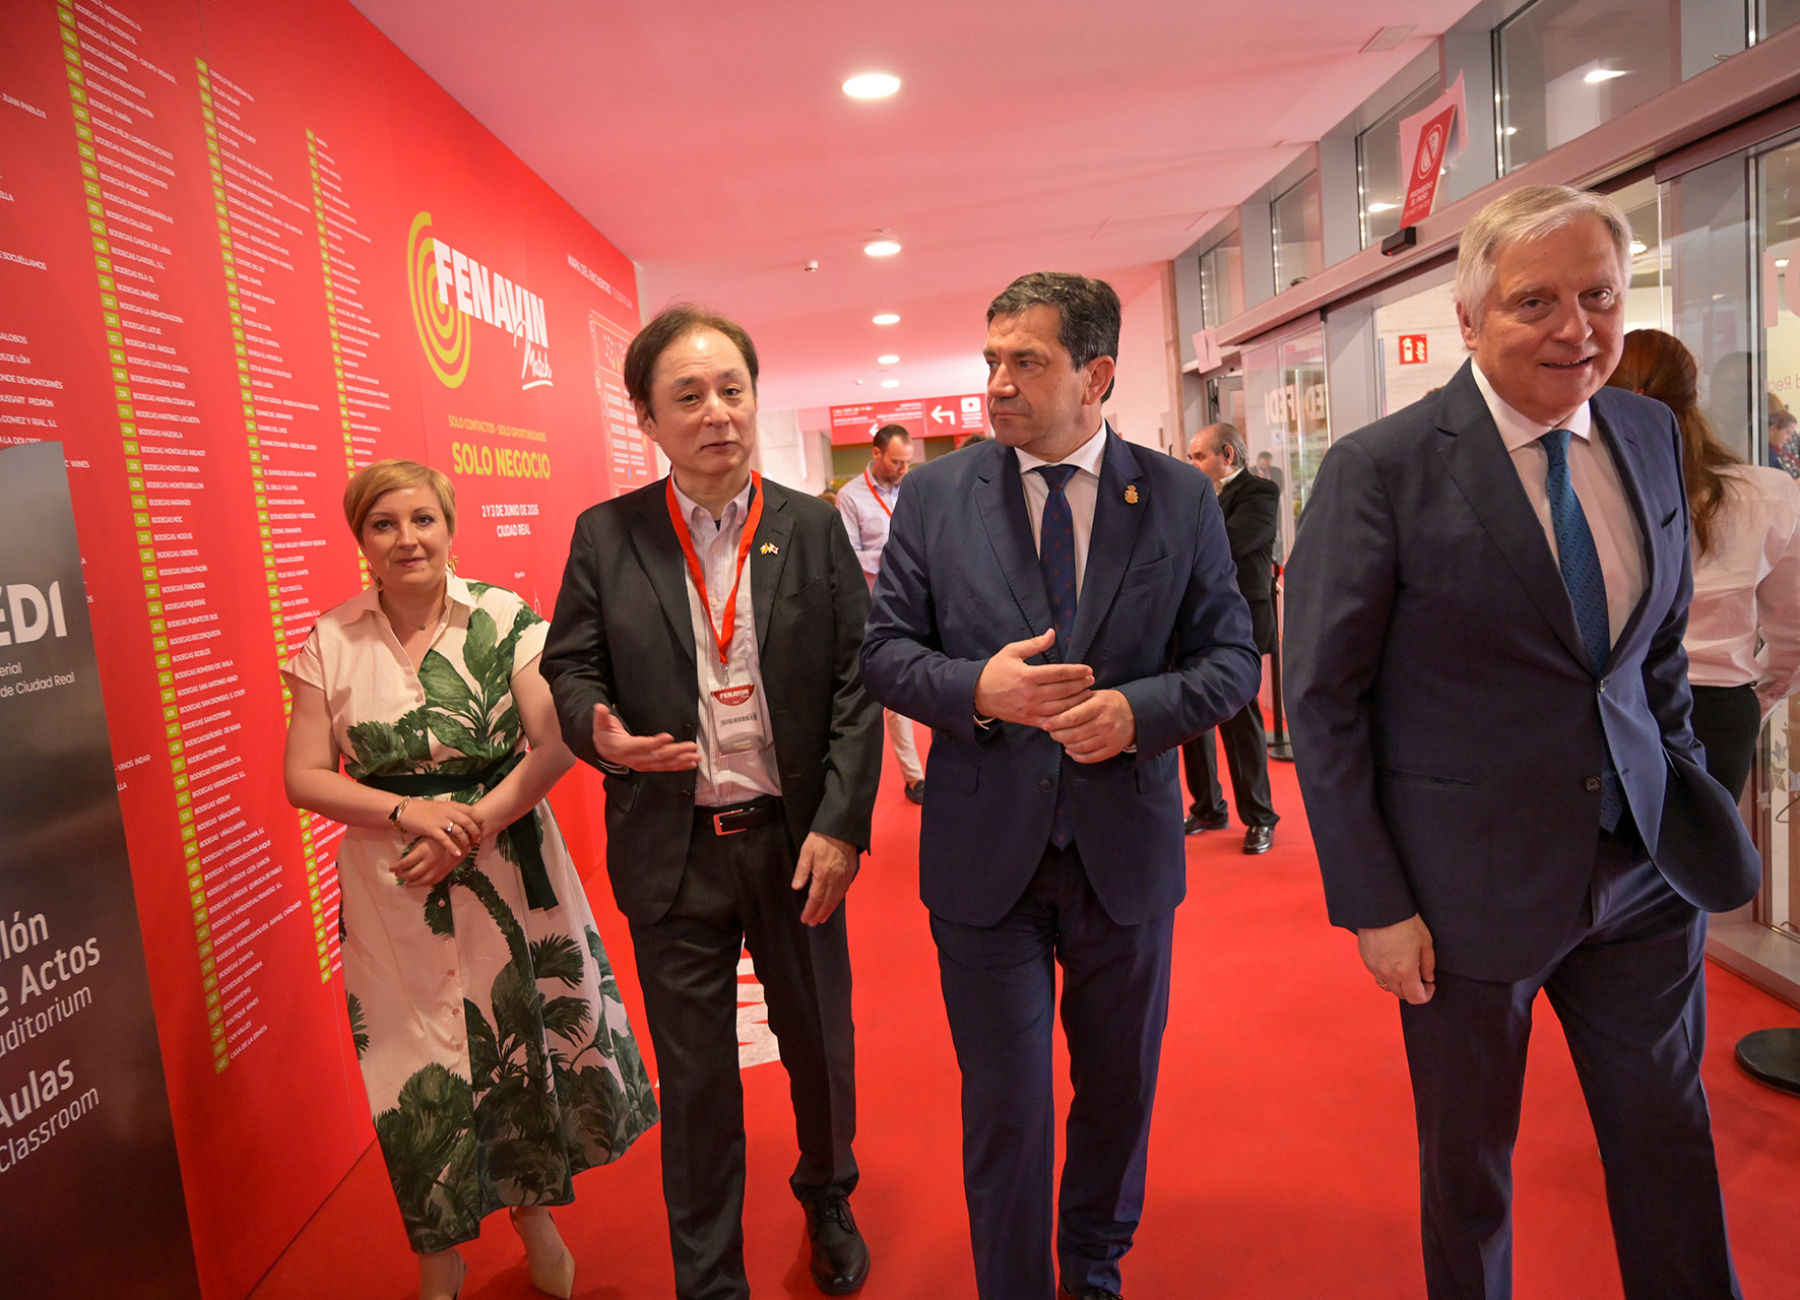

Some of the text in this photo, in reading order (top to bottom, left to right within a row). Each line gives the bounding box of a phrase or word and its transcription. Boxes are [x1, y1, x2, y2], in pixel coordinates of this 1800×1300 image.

[432, 237, 549, 349] FENAVIN
[448, 415, 464, 428] SOLO
[464, 417, 495, 434] CONTACTOS
[71, 460, 90, 469] WINES
[452, 441, 551, 480] SOLO NEGOCIO
[481, 505, 487, 517] 2
[490, 504, 496, 517] 3
[495, 504, 504, 517] DE
[504, 504, 520, 517] JUNIO
[520, 504, 528, 516] DE
[154, 532, 175, 540] BODEGAS
[497, 523, 532, 538] CIUDAD REAL
[156, 549, 179, 558] BODEGAS
[162, 583, 183, 593] BODEGAS
[164, 600, 185, 610] BODEGAS
[167, 617, 187, 628] BODEGAS
[169, 634, 191, 645] BODEGAS
[172, 650, 193, 662] BODEGAS
[175, 667, 196, 679] BODEGAS
[15, 675, 54, 694] Ciudad
[54, 671, 75, 687] Real
[177, 684, 198, 696] BODEGAS
[182, 717, 203, 731] BODEGAS
[20, 936, 101, 1005] Actos
